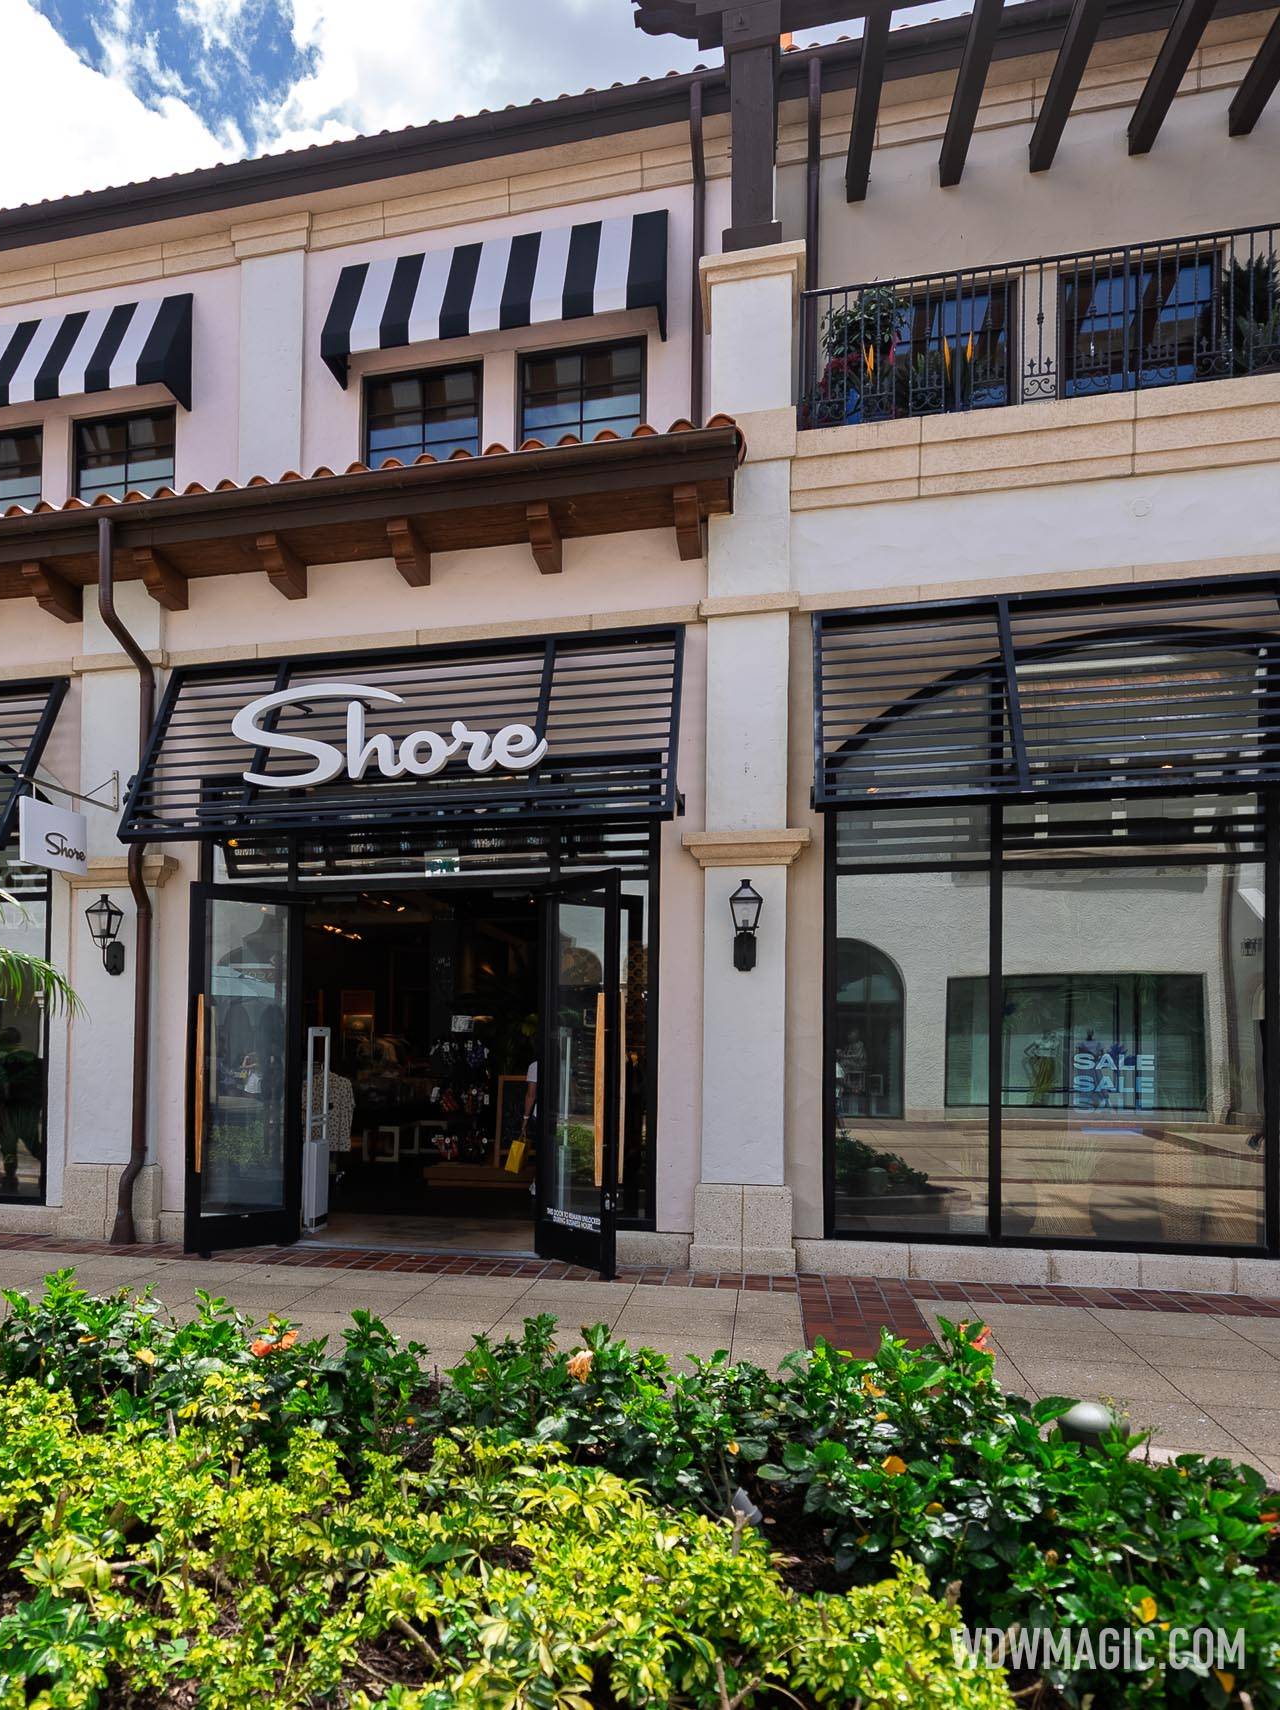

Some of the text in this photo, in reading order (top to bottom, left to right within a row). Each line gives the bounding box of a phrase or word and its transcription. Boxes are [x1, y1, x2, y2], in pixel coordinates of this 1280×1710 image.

[231, 683, 548, 787] Shore
[45, 832, 86, 861] Shore
[1073, 1053, 1155, 1071] SALE
[1073, 1075, 1155, 1093] SALE
